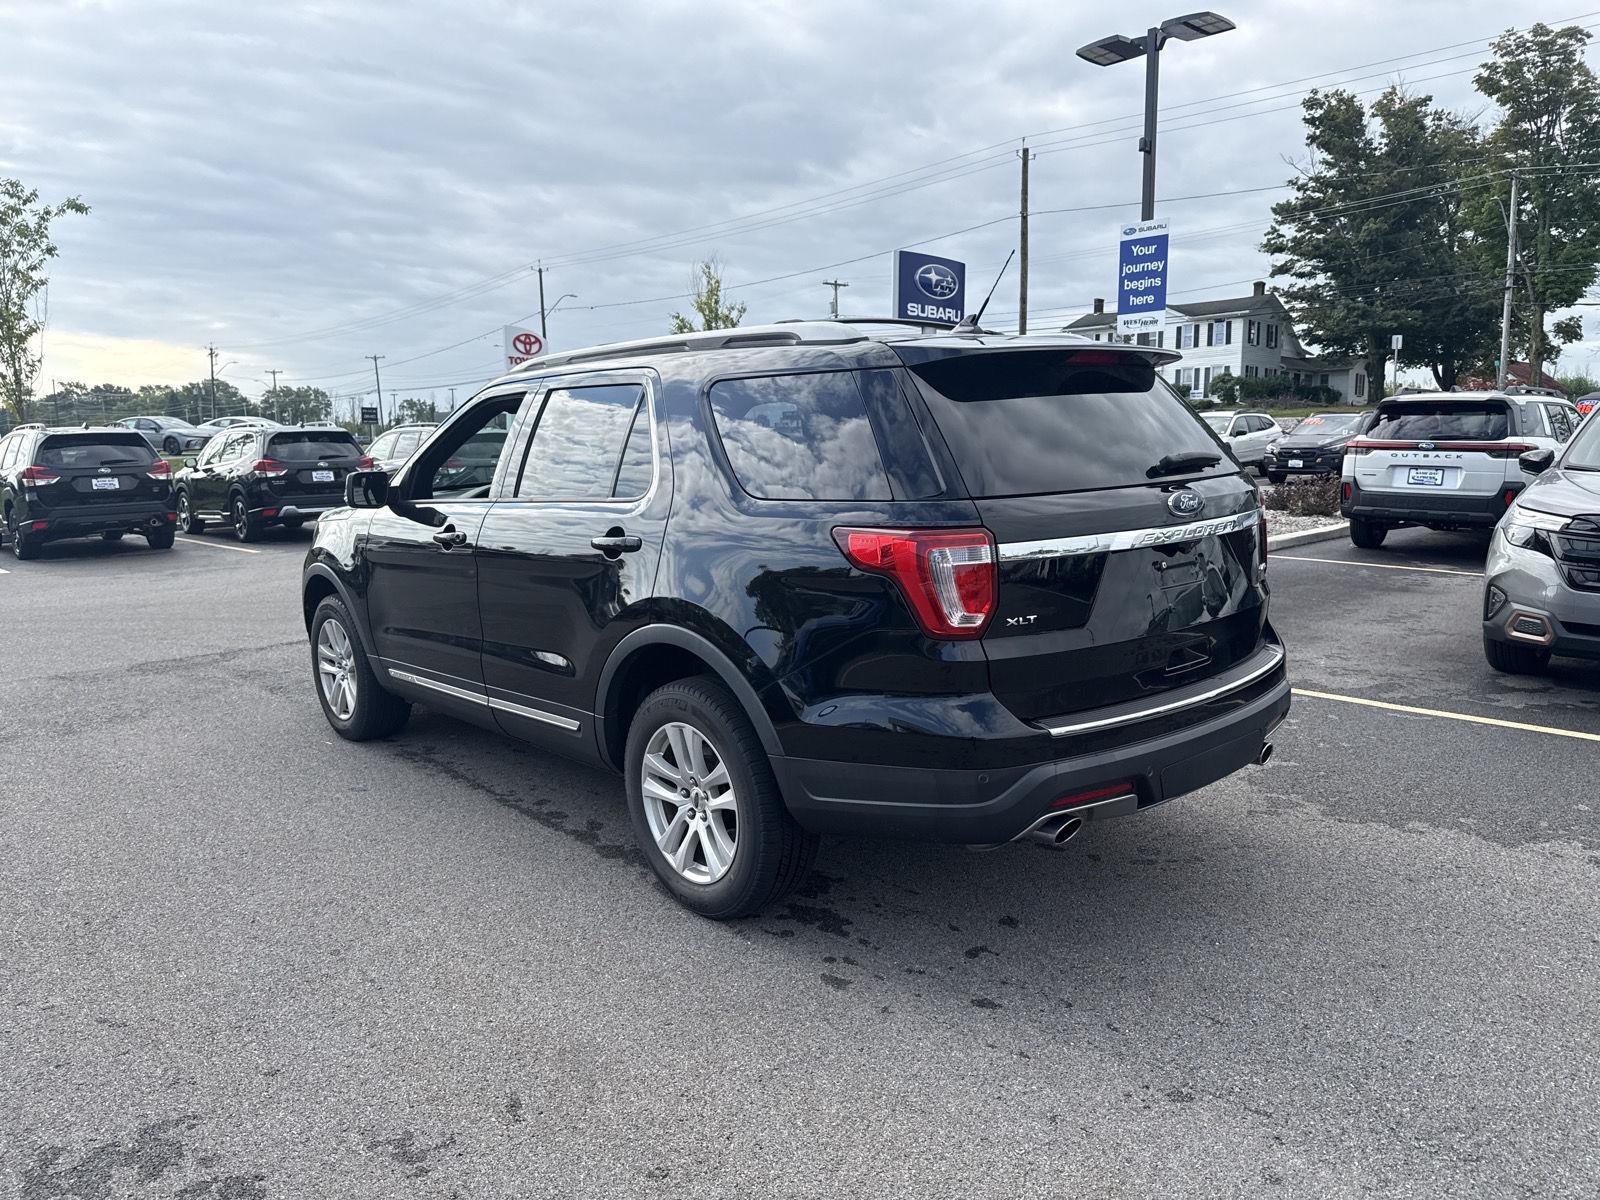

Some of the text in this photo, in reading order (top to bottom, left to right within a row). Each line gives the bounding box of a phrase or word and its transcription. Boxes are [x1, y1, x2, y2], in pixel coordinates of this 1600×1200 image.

[1138, 224, 1167, 233] SUBARU
[1131, 244, 1157, 257] Your
[1121, 260, 1165, 277] journey
[1124, 276, 1162, 291] begins
[1129, 294, 1155, 306] here
[907, 302, 961, 323] SUBARU
[1390, 452, 1464, 460] OUTBACK
[1180, 494, 1199, 510] Ford
[1142, 520, 1237, 543] EXPLORER
[1006, 615, 1038, 627] XLT
